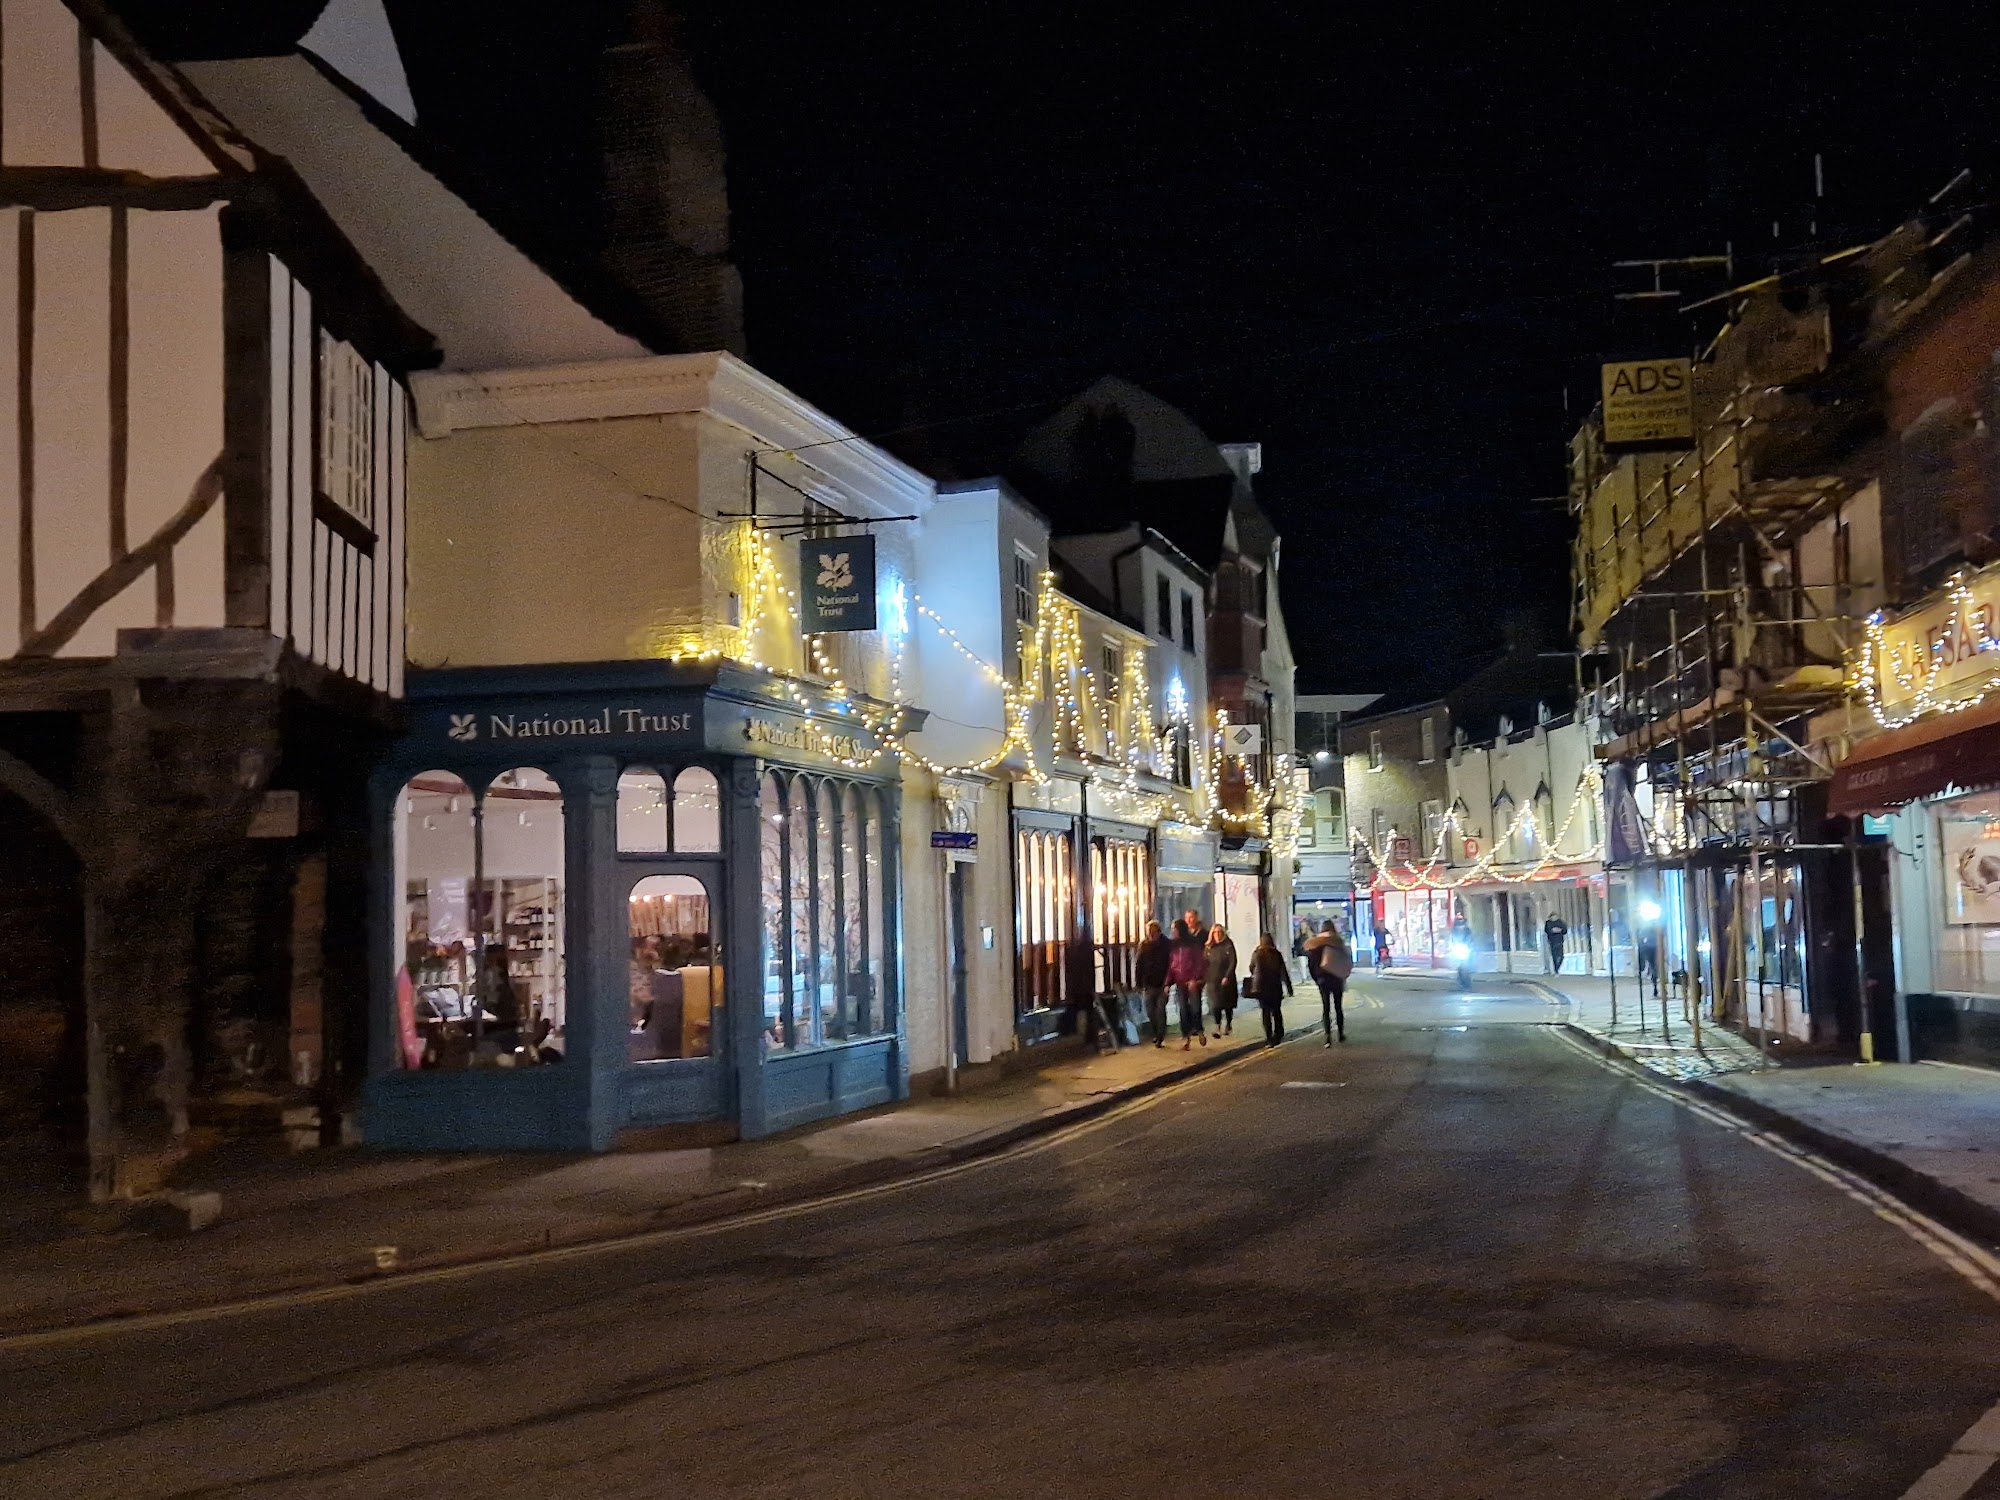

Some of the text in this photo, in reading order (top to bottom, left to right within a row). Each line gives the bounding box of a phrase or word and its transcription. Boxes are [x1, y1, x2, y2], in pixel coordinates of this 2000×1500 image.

[1611, 365, 1684, 396] ADS
[816, 592, 860, 606] National
[817, 607, 844, 617] Trust
[490, 706, 692, 738] National Trust
[761, 722, 804, 749] National
[833, 735, 851, 757] Gift
